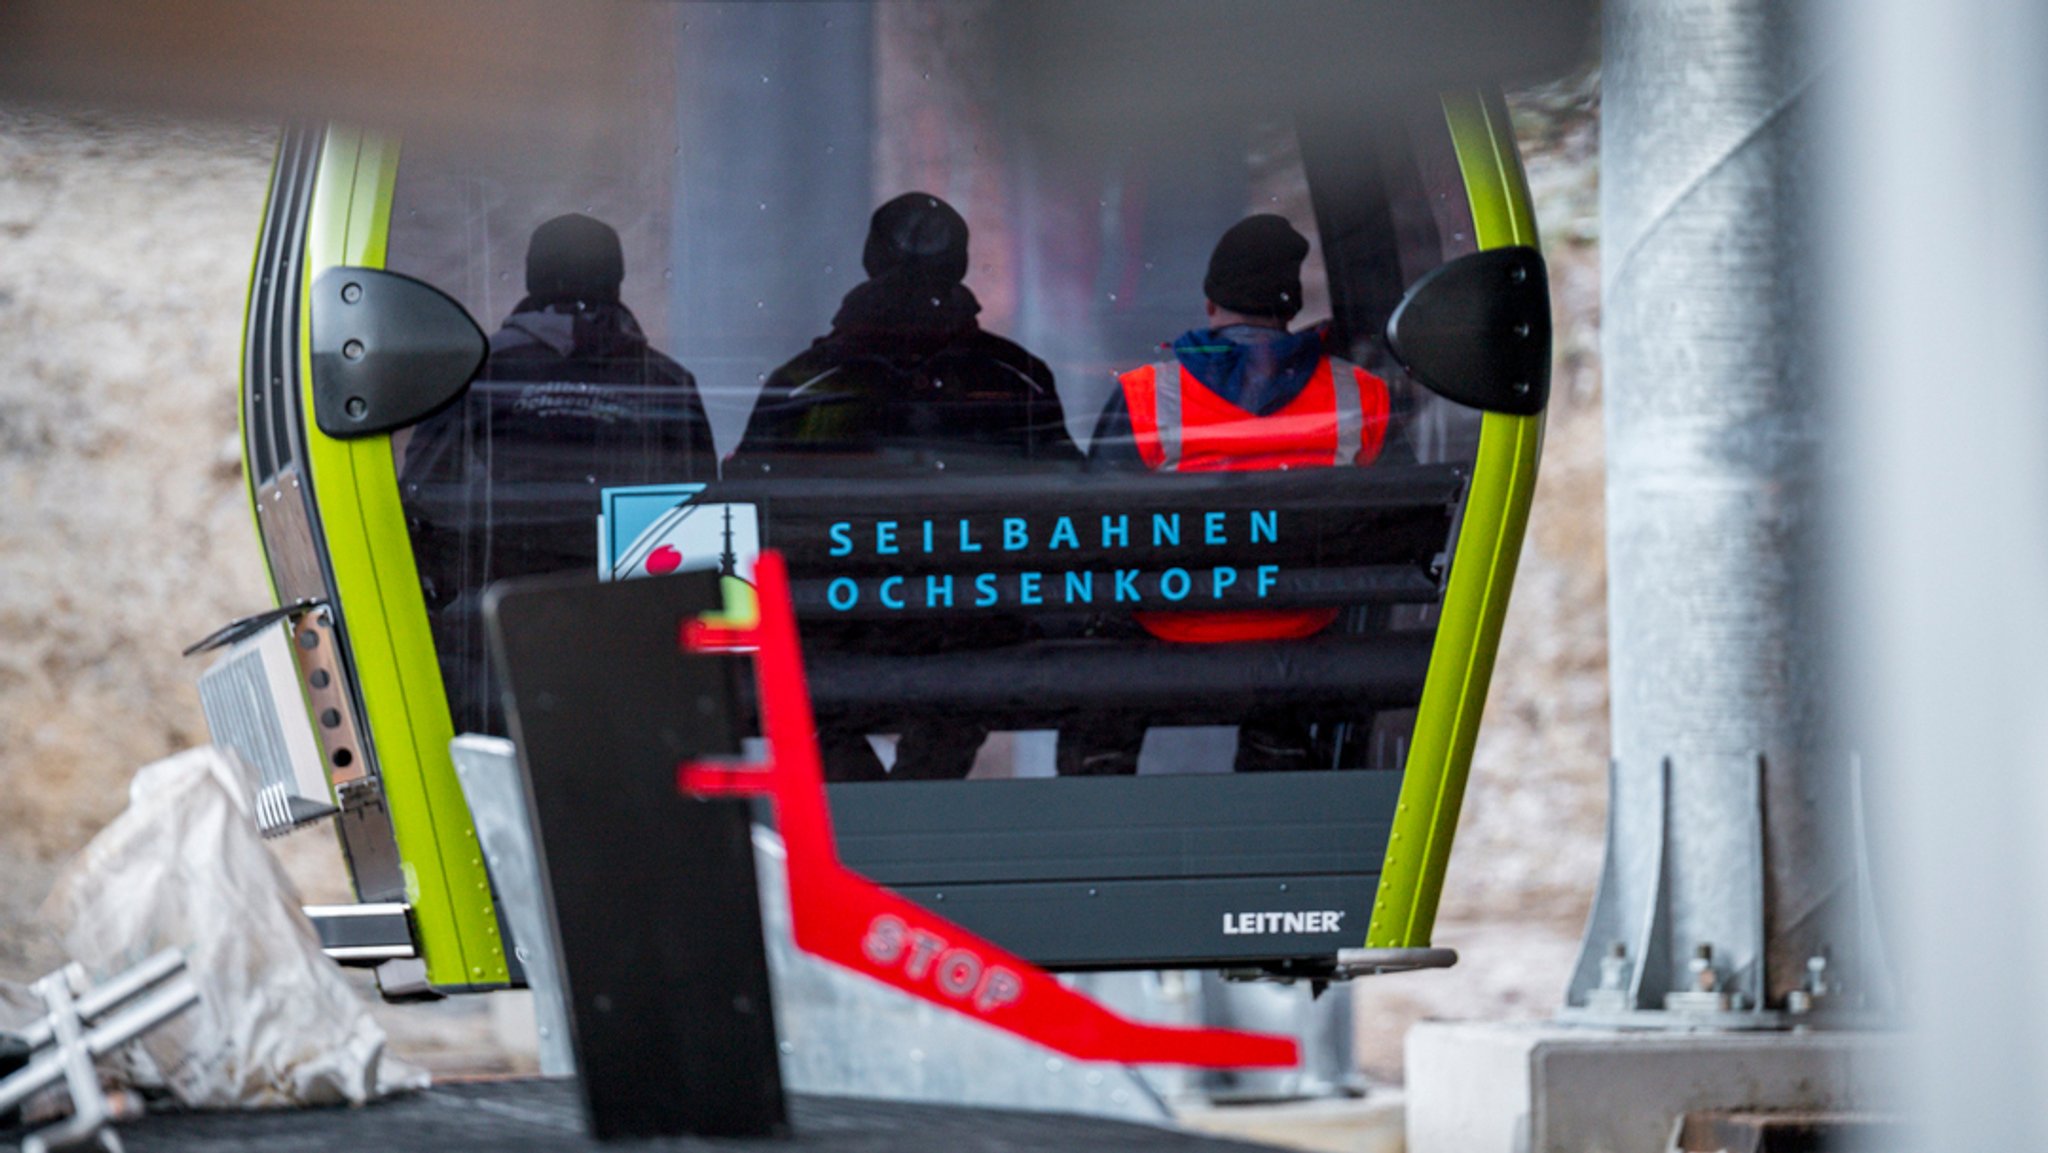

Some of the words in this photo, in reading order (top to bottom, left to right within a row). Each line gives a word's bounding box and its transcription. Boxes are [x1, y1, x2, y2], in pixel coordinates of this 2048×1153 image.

[829, 510, 1278, 557] SEILBAHNEN
[827, 565, 1279, 611] OCHSENKOPF
[862, 915, 1021, 1012] STOP
